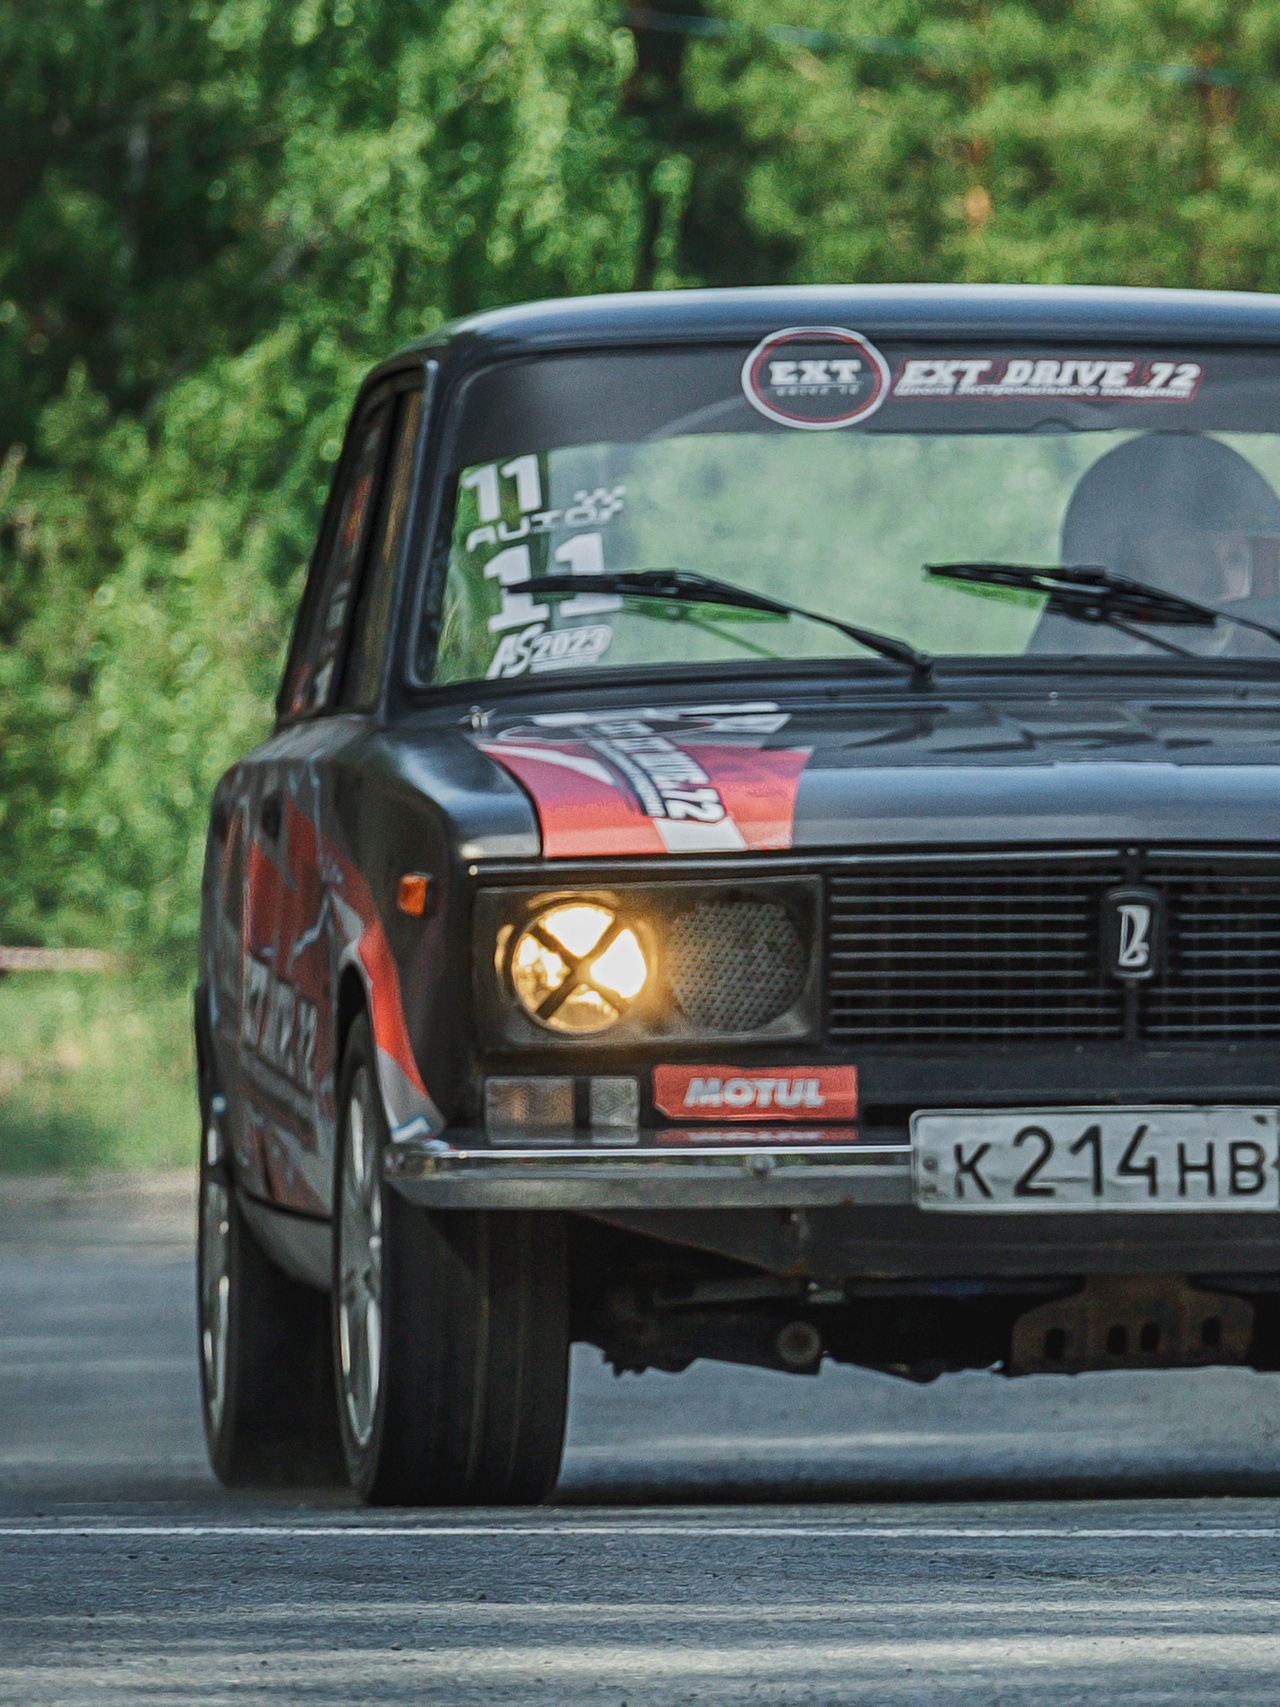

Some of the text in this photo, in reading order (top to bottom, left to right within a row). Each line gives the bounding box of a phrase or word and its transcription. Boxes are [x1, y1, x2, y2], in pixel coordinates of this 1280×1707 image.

[769, 359, 861, 385] EXT
[899, 359, 1201, 389] EXT DRIVE 72
[461, 453, 542, 522] 11
[483, 532, 625, 633] 11
[683, 1077, 826, 1109] MOTUL
